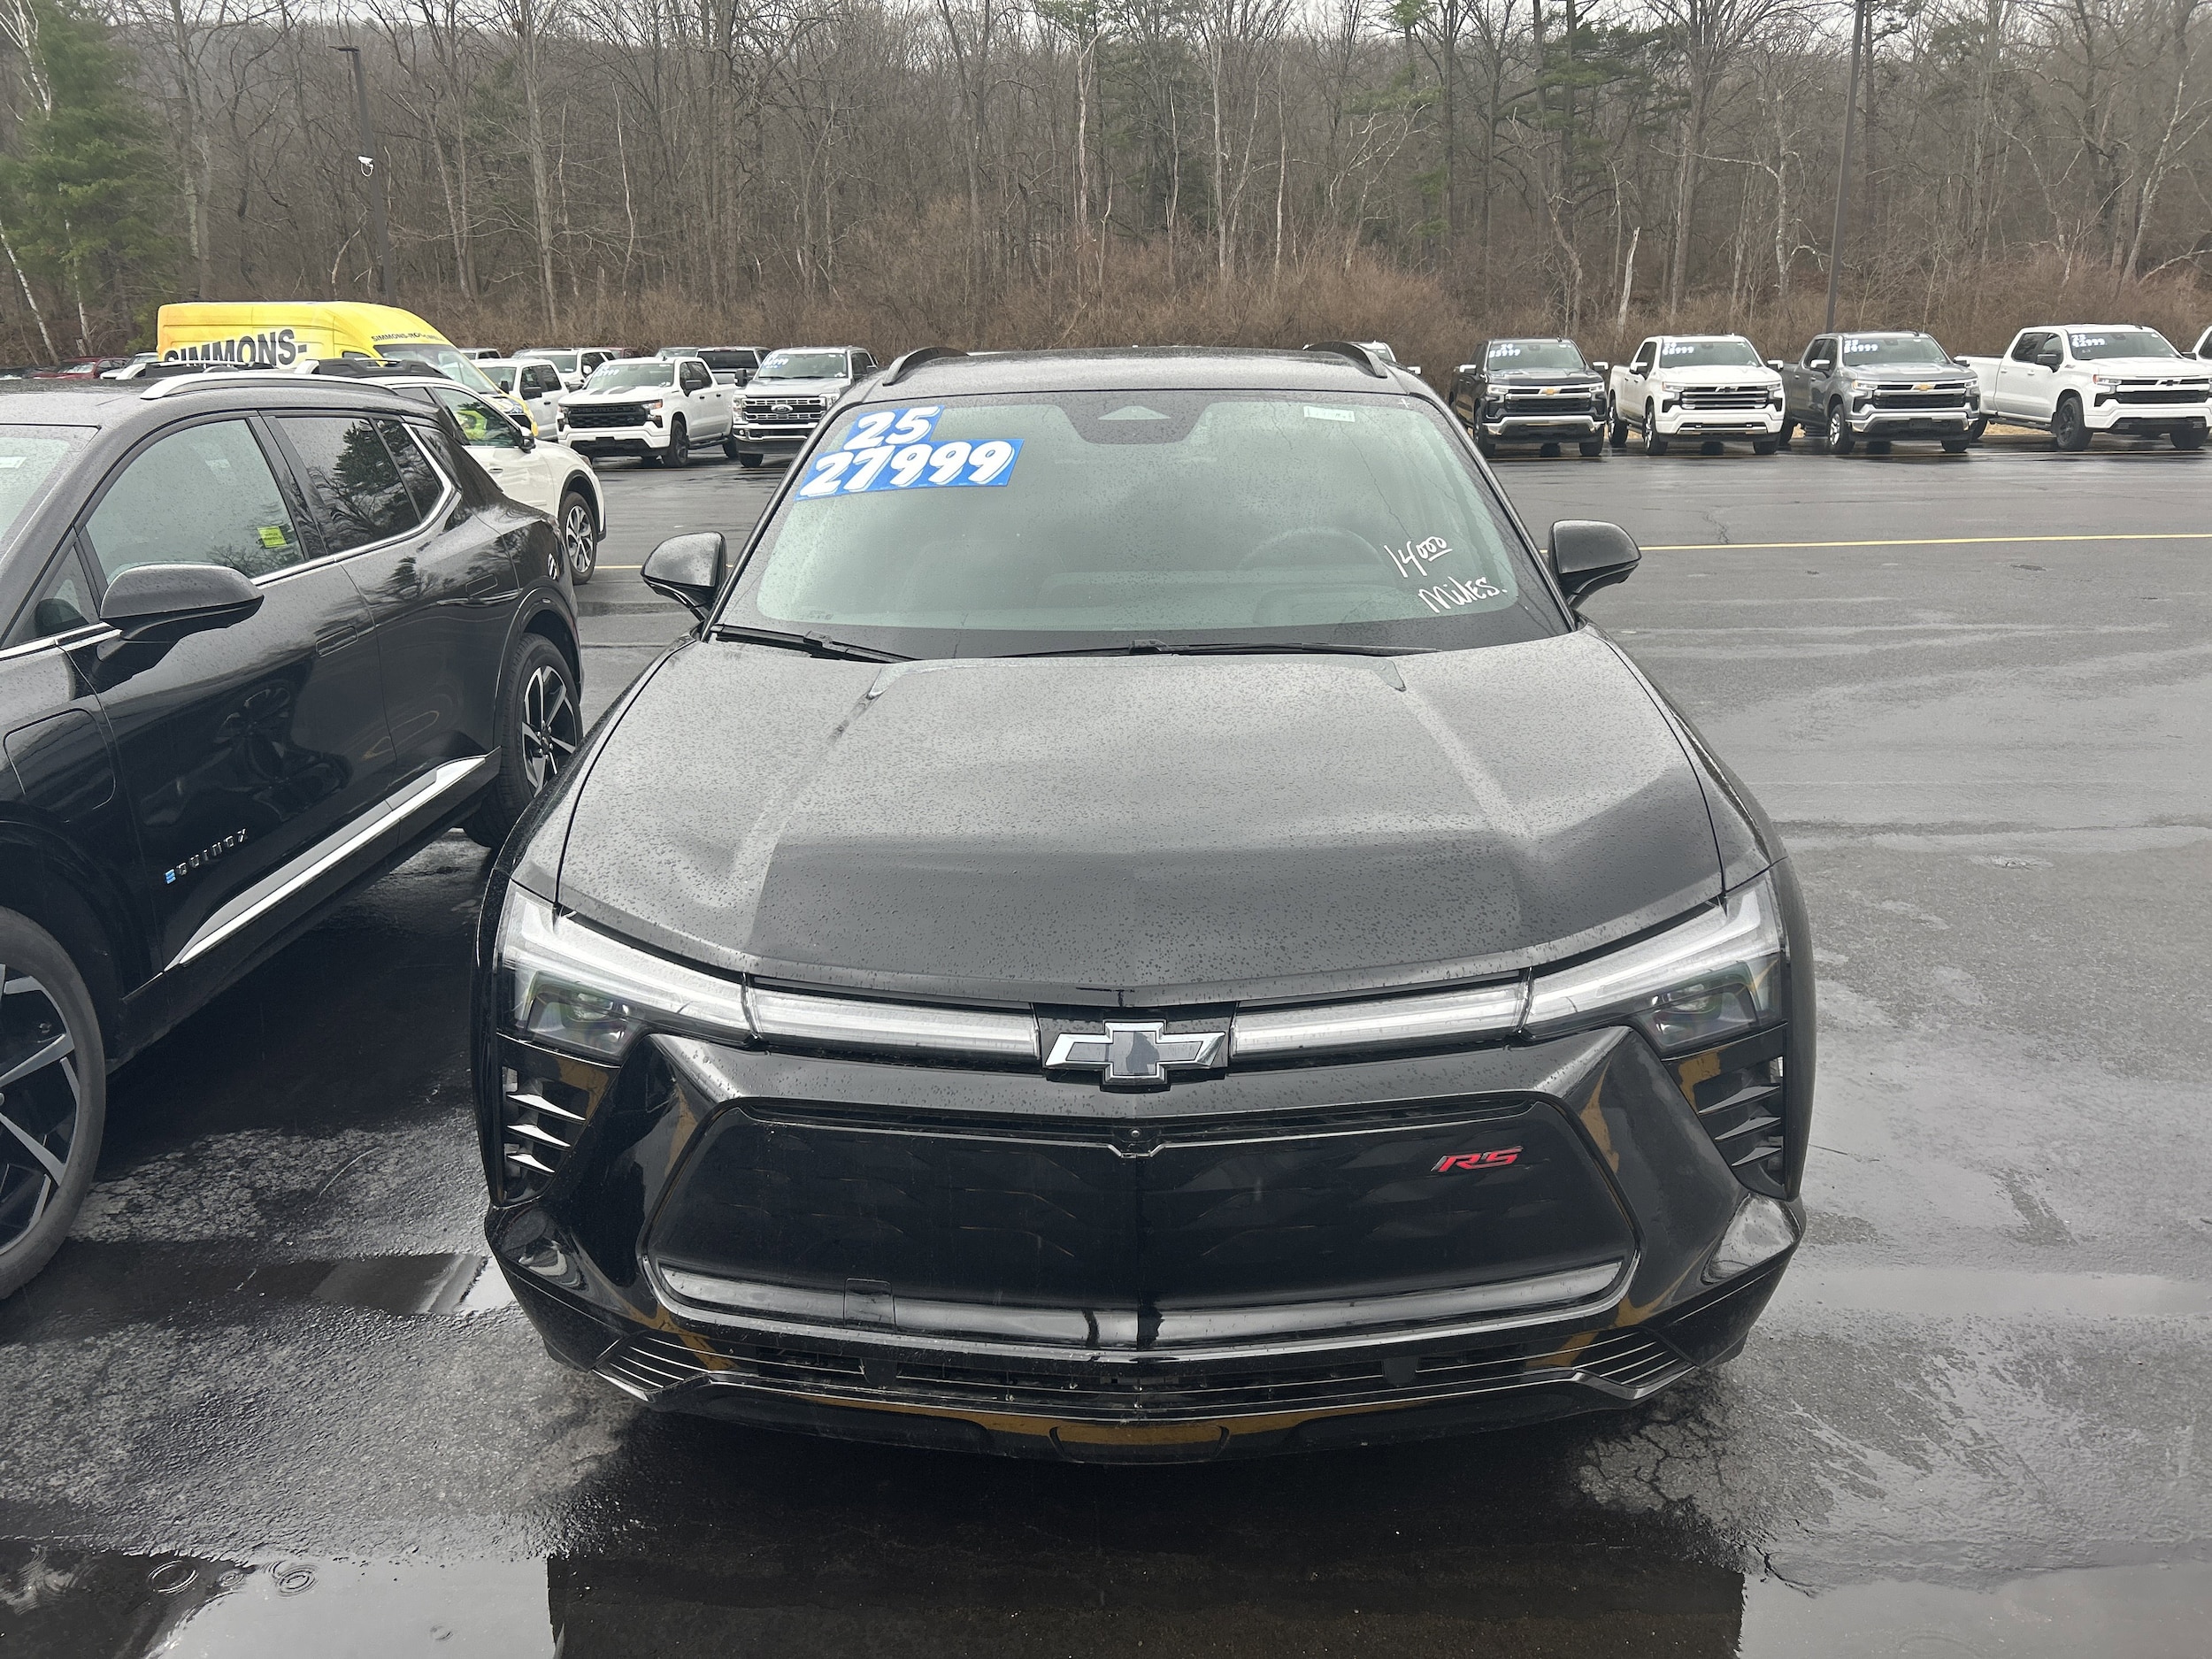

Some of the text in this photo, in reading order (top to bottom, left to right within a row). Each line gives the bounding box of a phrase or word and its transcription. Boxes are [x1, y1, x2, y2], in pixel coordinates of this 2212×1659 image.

[843, 406, 941, 450] 25
[800, 441, 1015, 497] 27999
[165, 828, 248, 884] EQUINOX
[1431, 1146, 1523, 1172] RS
